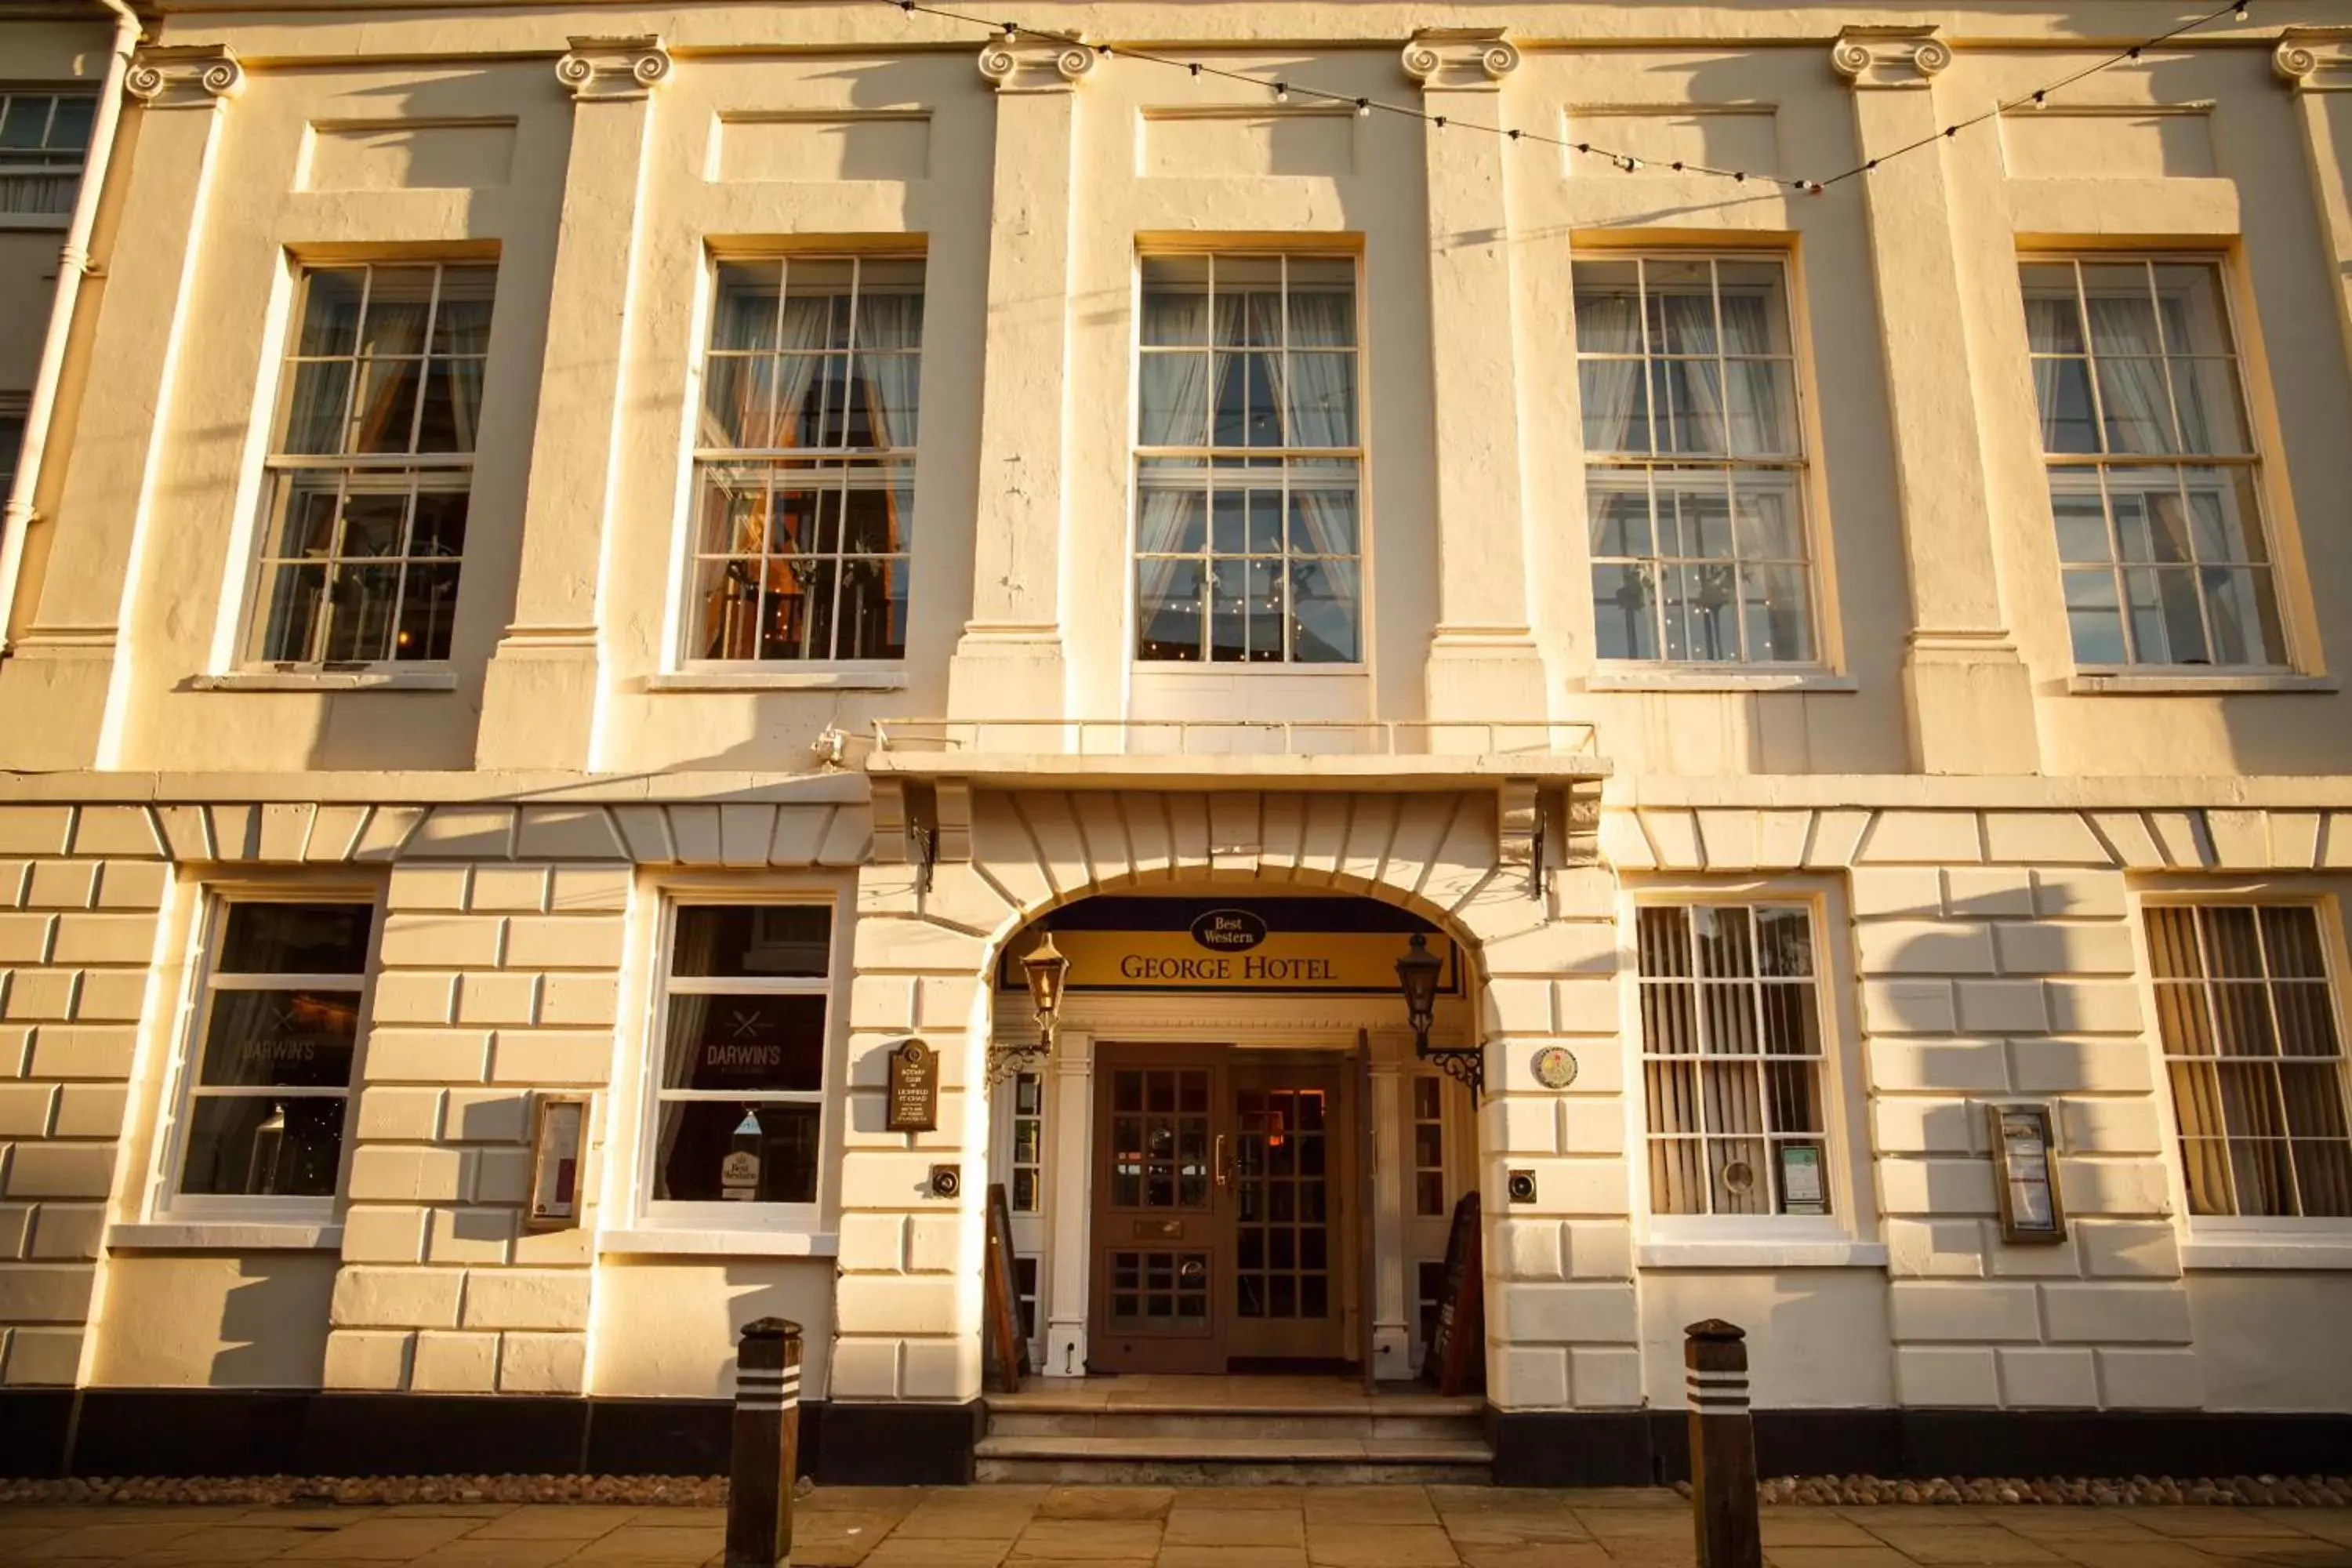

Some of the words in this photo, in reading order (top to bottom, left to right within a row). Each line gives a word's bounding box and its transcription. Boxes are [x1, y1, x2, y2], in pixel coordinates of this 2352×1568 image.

[1215, 916, 1243, 930] Best
[1203, 930, 1254, 944] Western
[1120, 954, 1231, 979] GEORGE
[1243, 955, 1338, 979] HOTEL
[707, 1045, 781, 1065] DARWIN'S
